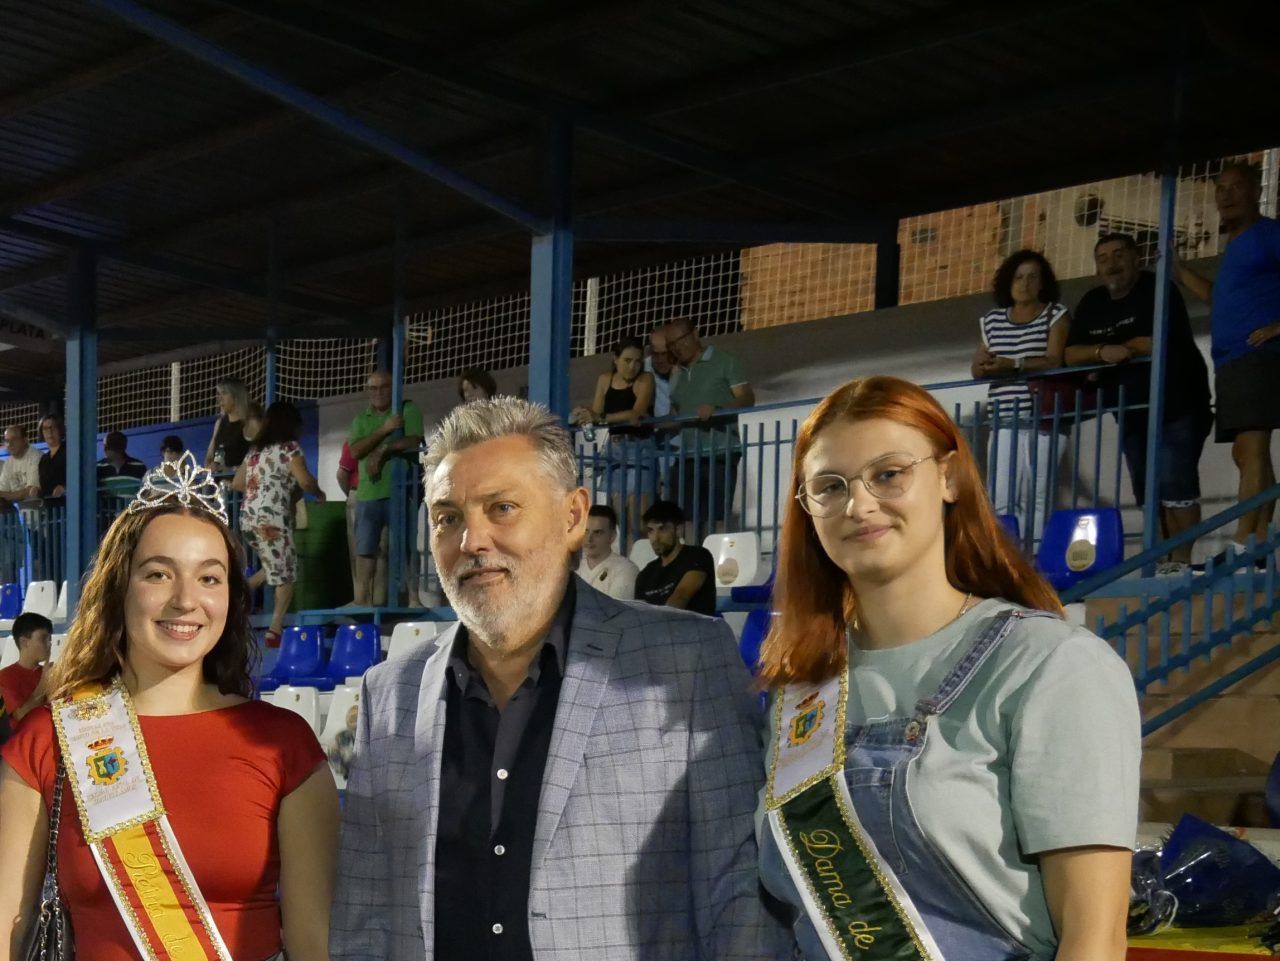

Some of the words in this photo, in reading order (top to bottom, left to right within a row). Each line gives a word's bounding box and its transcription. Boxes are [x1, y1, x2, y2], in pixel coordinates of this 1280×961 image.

[0, 318, 45, 339] PLATA
[123, 852, 165, 919] Reina
[163, 933, 191, 959] de
[799, 829, 853, 909] Dama
[847, 921, 882, 950] de
